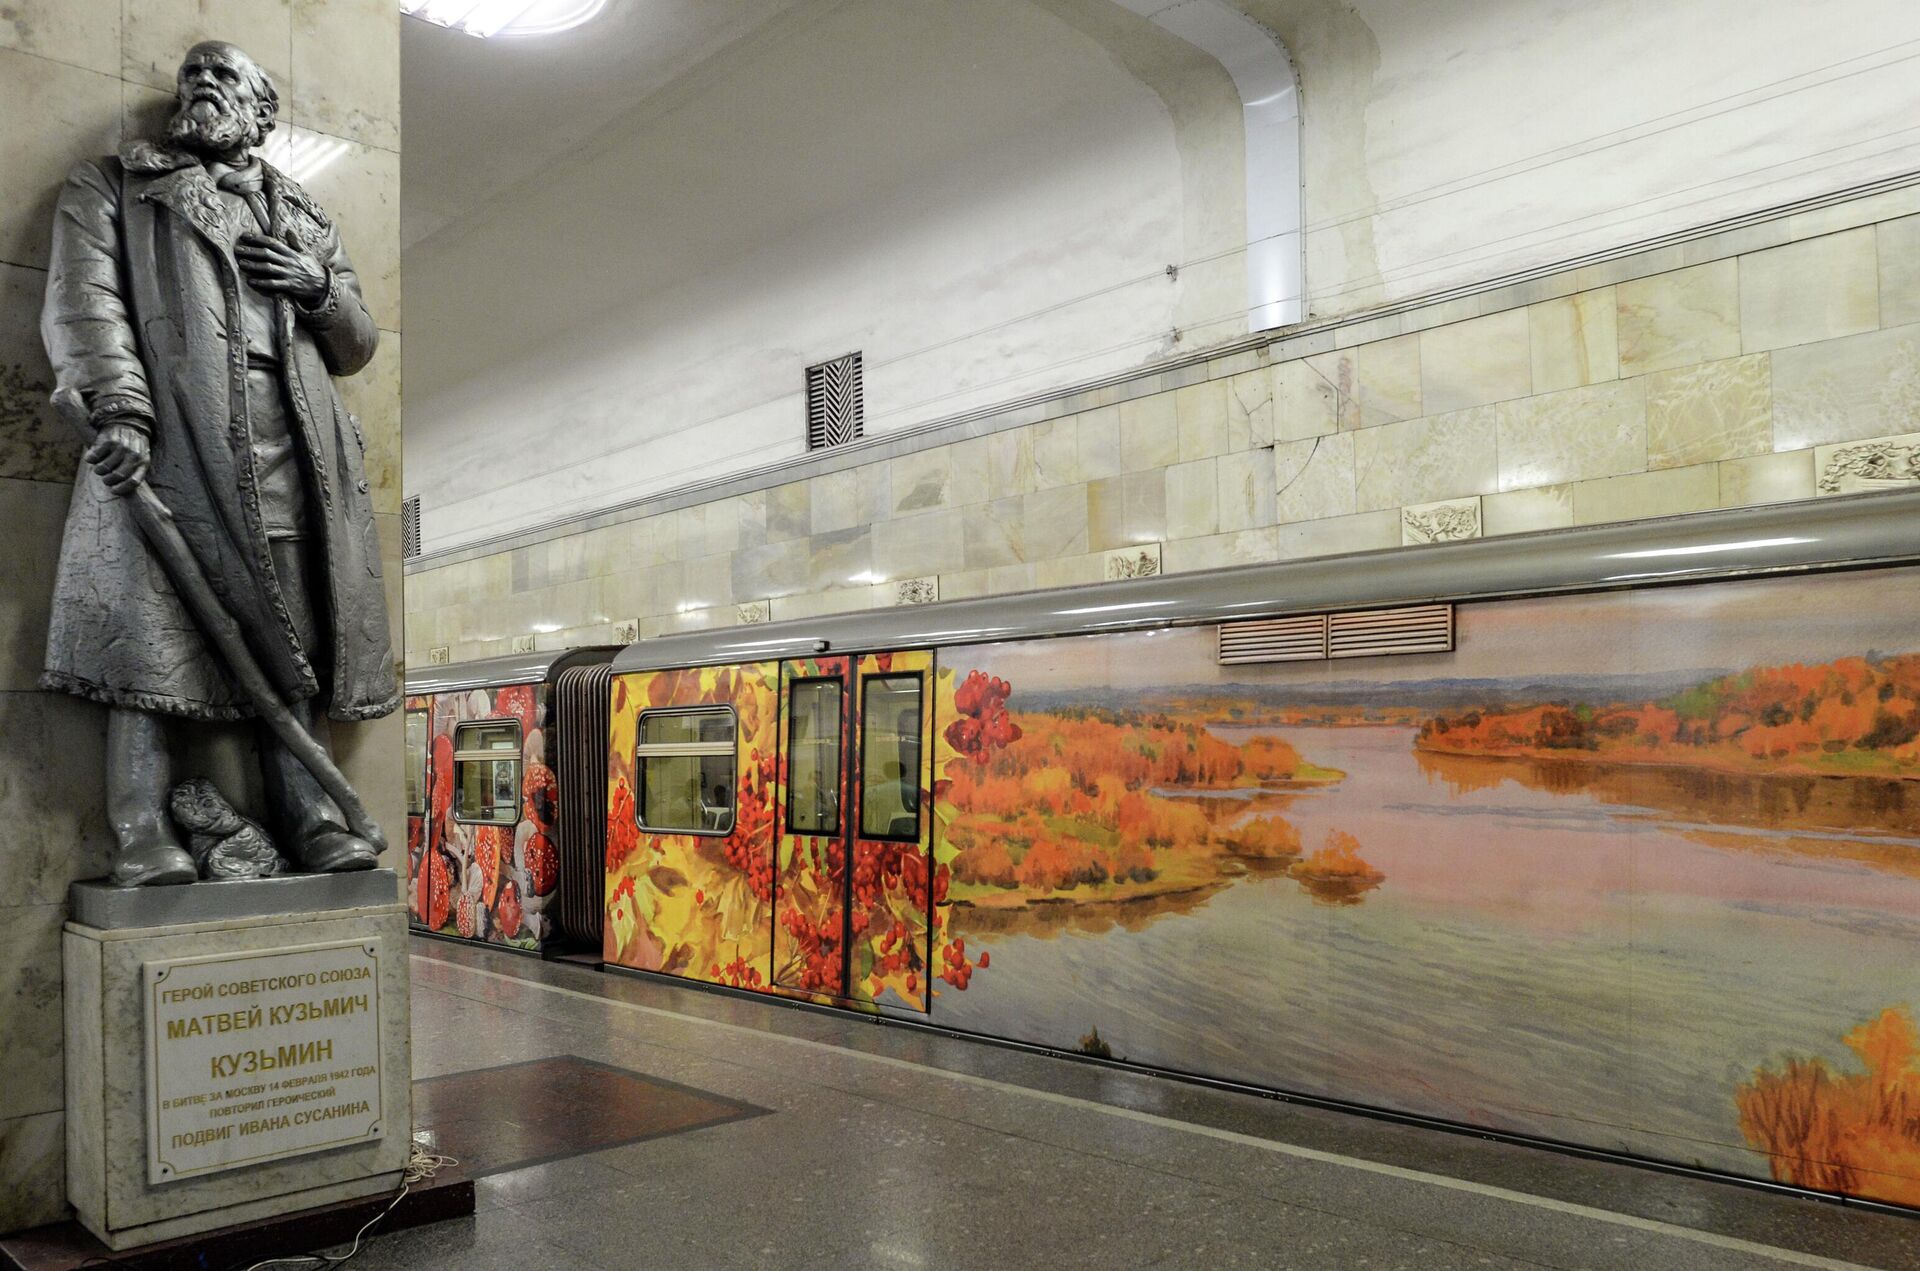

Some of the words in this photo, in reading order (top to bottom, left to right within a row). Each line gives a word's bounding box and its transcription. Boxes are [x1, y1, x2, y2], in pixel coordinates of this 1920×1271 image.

[162, 983, 213, 1004] ГЕРОЙ
[218, 974, 315, 996] СОВЕТСКОГО
[320, 966, 371, 983] СОЮЗА
[167, 1005, 262, 1039] МАТВЕЙ
[270, 995, 368, 1026] КУЗЬМИЧ
[211, 1040, 333, 1079] КУЗЬМИН
[163, 1100, 170, 1110] В
[173, 1094, 207, 1108] БИТВЕ
[210, 1092, 223, 1101] ЗА
[226, 1084, 266, 1099] МОСКВУ
[269, 1082, 279, 1092] 14
[282, 1073, 327, 1090] ФЕВРАЛЯ
[330, 1071, 349, 1081] 1942
[352, 1066, 375, 1078] ГОДА
[210, 1101, 264, 1118] ПОВТОРИЛ
[267, 1087, 335, 1108] ГЕРОИЧЕСКИЙ
[172, 1125, 234, 1149] ПОДВИГ
[240, 1115, 290, 1135] ИВАНА
[294, 1101, 369, 1125] СУСАНИНА
